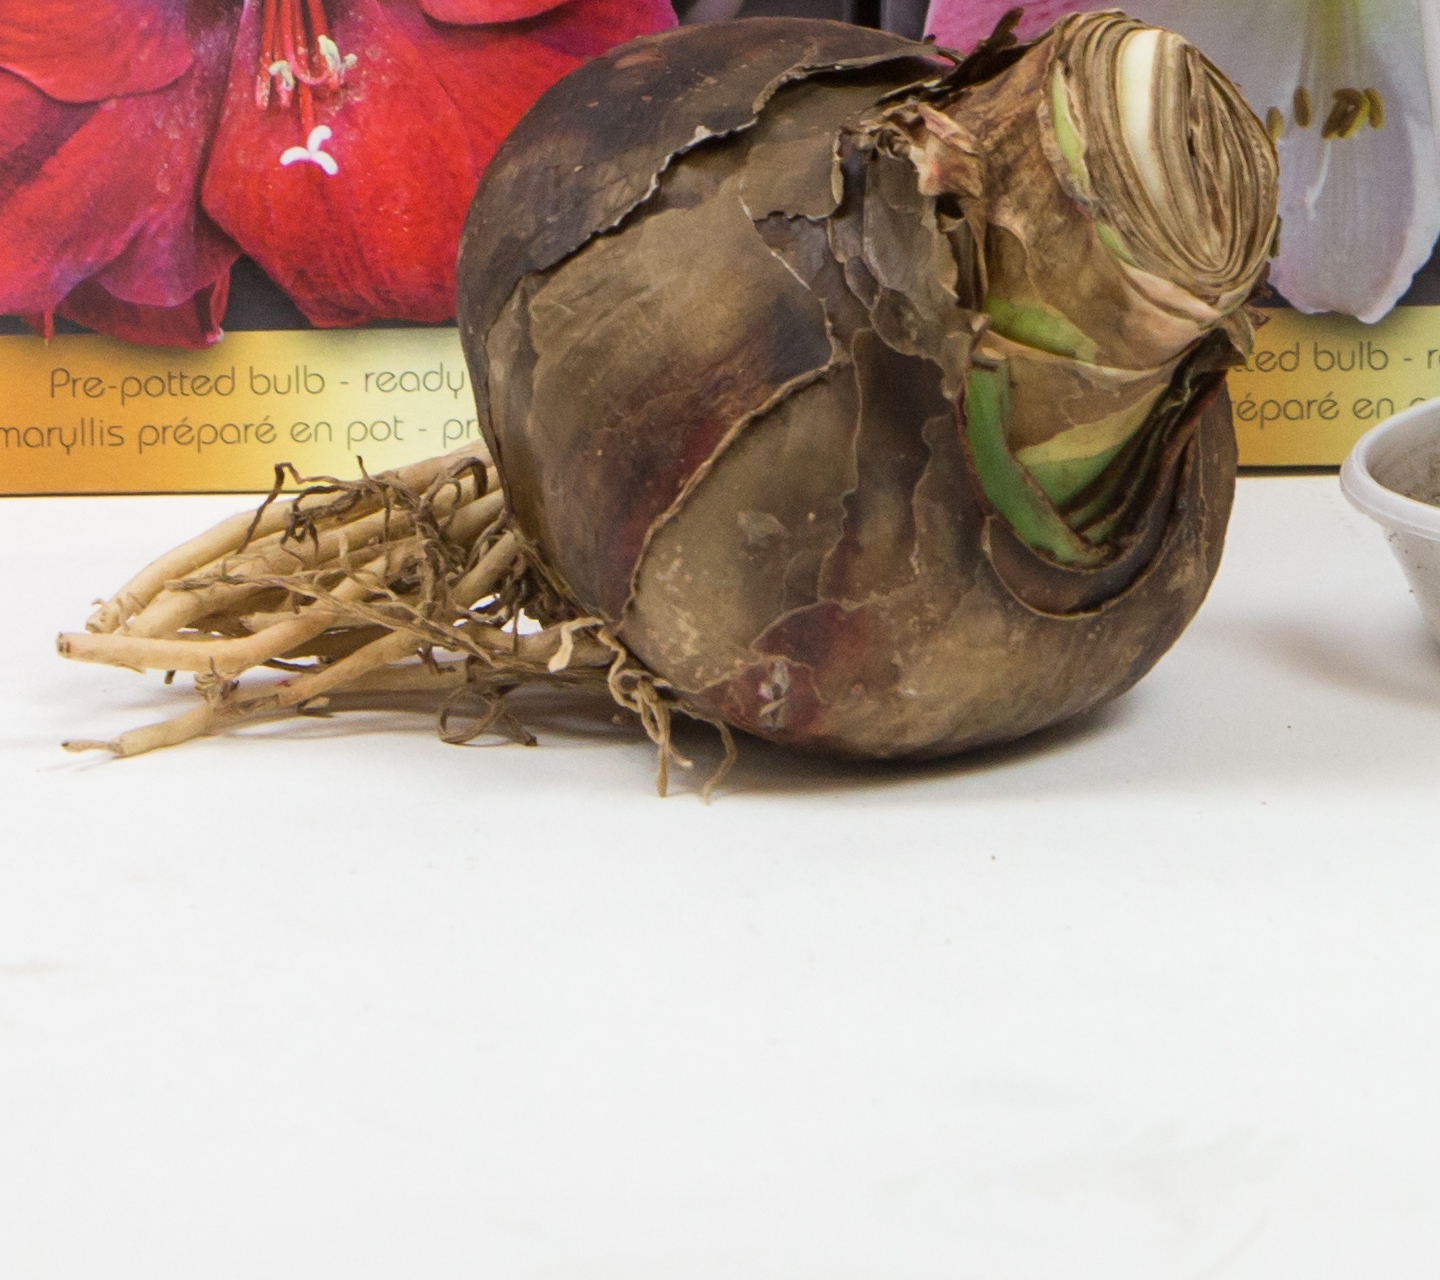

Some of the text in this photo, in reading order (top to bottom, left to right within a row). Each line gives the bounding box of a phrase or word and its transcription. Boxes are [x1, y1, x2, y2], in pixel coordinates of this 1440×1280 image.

[1314, 342, 1388, 371] bulb
[50, 366, 235, 406] Pre-potted
[250, 365, 325, 396] bulb
[364, 363, 464, 400] ready
[1235, 391, 1395, 430] éparé en
[139, 414, 277, 454] préparé
[291, 421, 332, 443] en
[347, 415, 403, 450] pot
